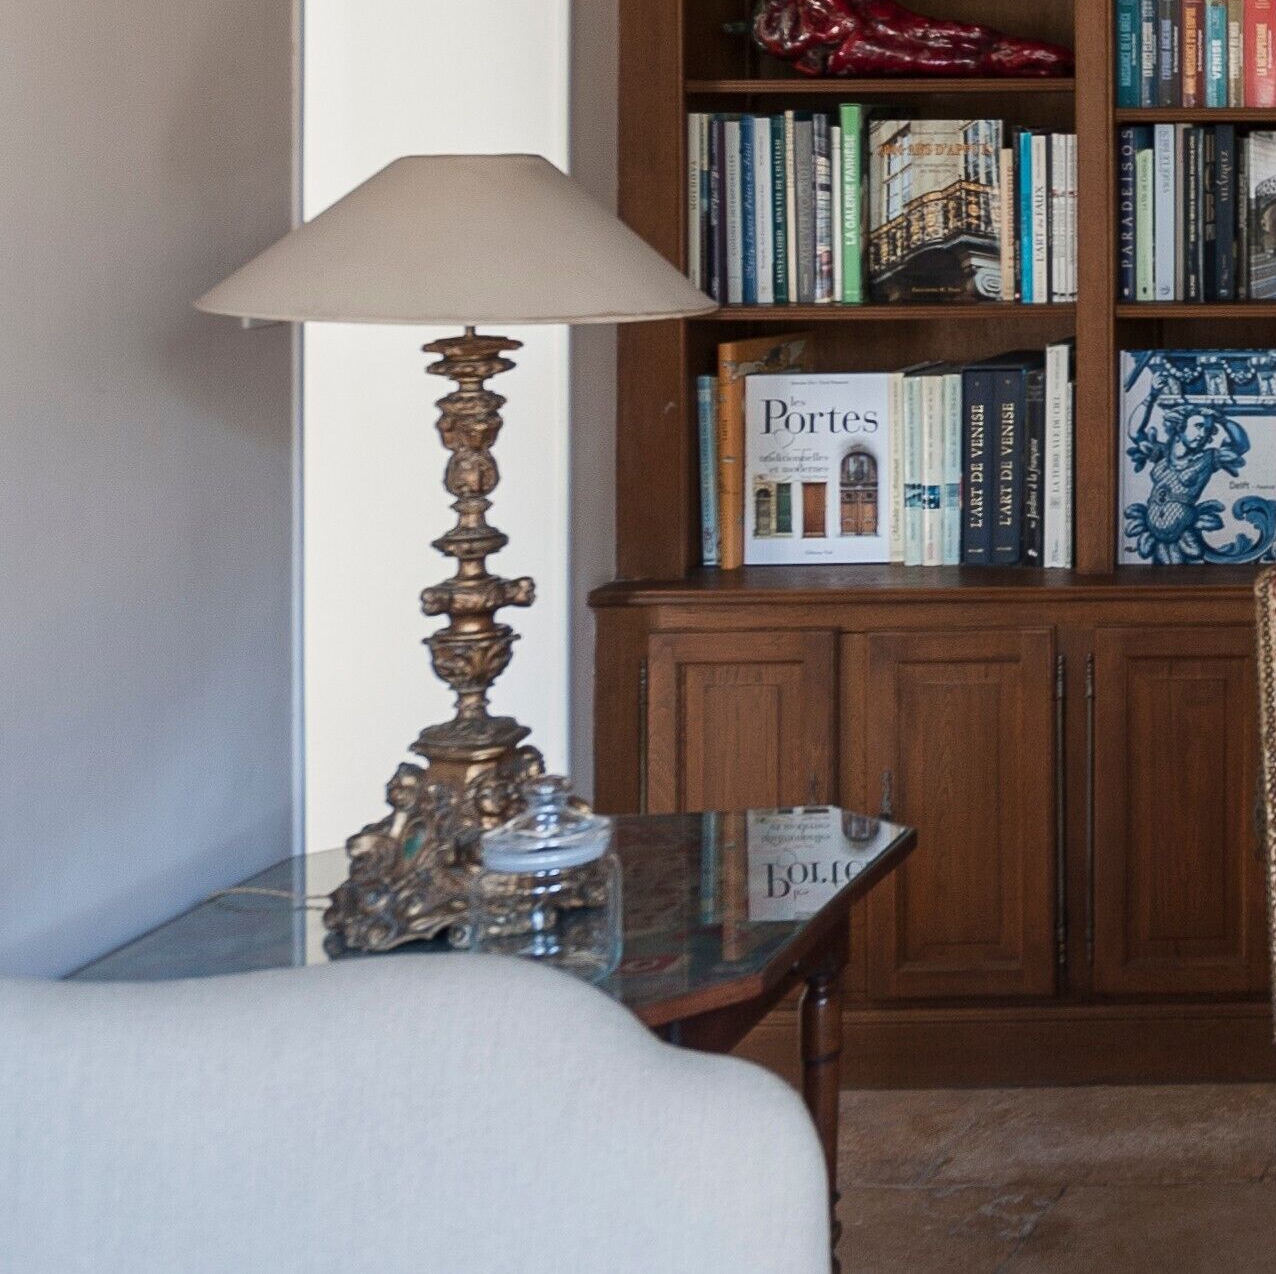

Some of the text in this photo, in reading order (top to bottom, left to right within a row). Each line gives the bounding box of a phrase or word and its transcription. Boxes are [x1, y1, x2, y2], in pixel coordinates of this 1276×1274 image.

[1211, 39, 1222, 80] VENISE
[845, 184, 857, 229] GALERIE
[1035, 186, 1044, 216] FAUX
[1121, 129, 1133, 269] PARADEISOS
[846, 231, 857, 246] LA
[1035, 233, 1044, 262] L'ART
[760, 399, 878, 435] Portes
[790, 396, 806, 406] les
[769, 465, 829, 474] et modernes
[970, 404, 984, 528] L'ART DE VENISE
[1000, 402, 1015, 526] L'ART DE VENISE
[1028, 438, 1041, 476] française
[1229, 481, 1250, 490] Delft
[1027, 491, 1040, 519] Jardins
